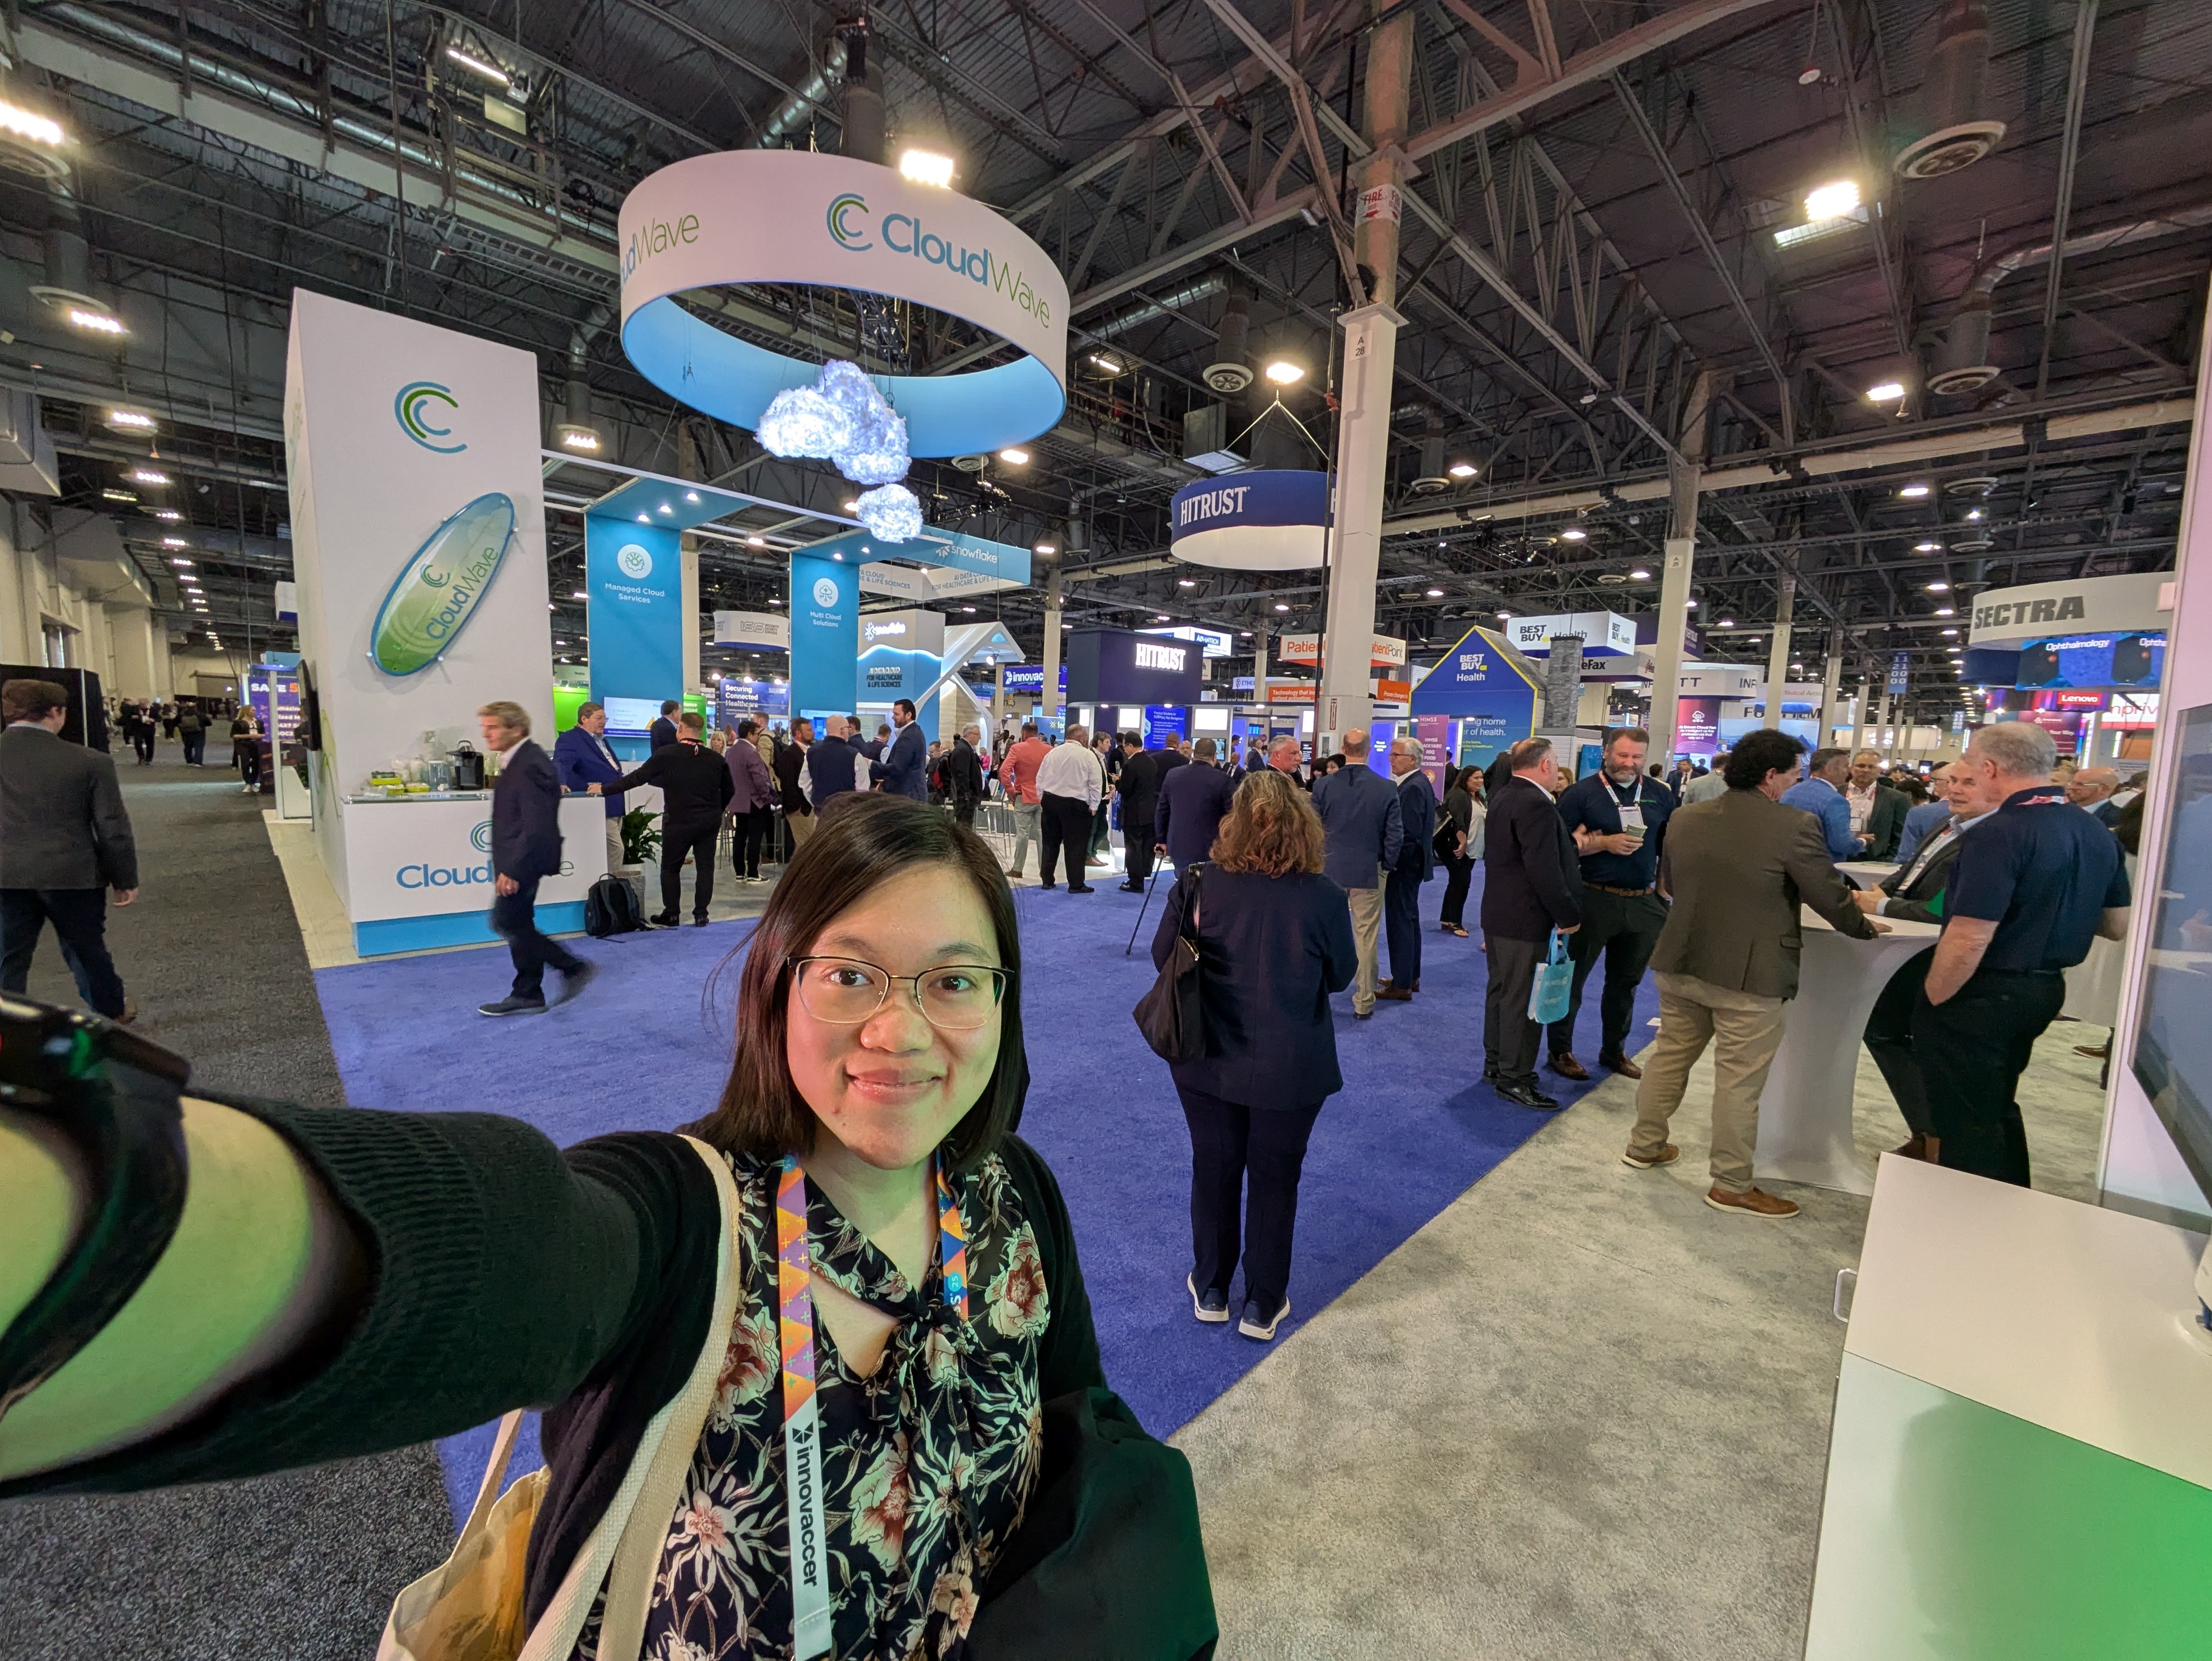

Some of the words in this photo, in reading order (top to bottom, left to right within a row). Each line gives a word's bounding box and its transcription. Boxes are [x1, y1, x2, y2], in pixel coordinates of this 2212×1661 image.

[1363, 189, 1382, 206] FIRE
[621, 214, 699, 285] udWave
[882, 212, 1050, 329] CloudWave
[1358, 336, 1364, 345] A
[1355, 346, 1365, 356] 28
[1180, 486, 1247, 526] HITRUST
[951, 545, 997, 563] snowflake
[865, 570, 885, 579] CLOUD
[885, 580, 910, 589] SCIENCES
[942, 578, 973, 589] HEALTHCARE
[425, 546, 498, 640] CloudWave
[605, 582, 641, 593] Managed
[643, 588, 665, 597] Cloud
[619, 593, 651, 603] Services
[1974, 596, 2084, 630] SECTRA
[740, 620, 764, 633] ISS
[813, 619, 839, 627] Solutions
[1520, 624, 1547, 634] BEST
[1521, 633, 1543, 642] BUY
[1371, 641, 1403, 658] atientPoint
[2046, 639, 2110, 652] Ophthalmology
[1136, 643, 1186, 671] HITRUST
[1460, 653, 1484, 663] BEST
[1461, 662, 1482, 670] BUY
[1013, 672, 1044, 682] innovac
[1457, 672, 1485, 681] Health
[251, 683, 287, 693] SAE
[725, 685, 752, 694] Securing
[725, 692, 758, 700] Connected
[1470, 728, 1478, 736] of
[1480, 728, 1506, 736] health.
[951, 1275, 959, 1288] 25
[791, 1444, 817, 1587] innovaccer
